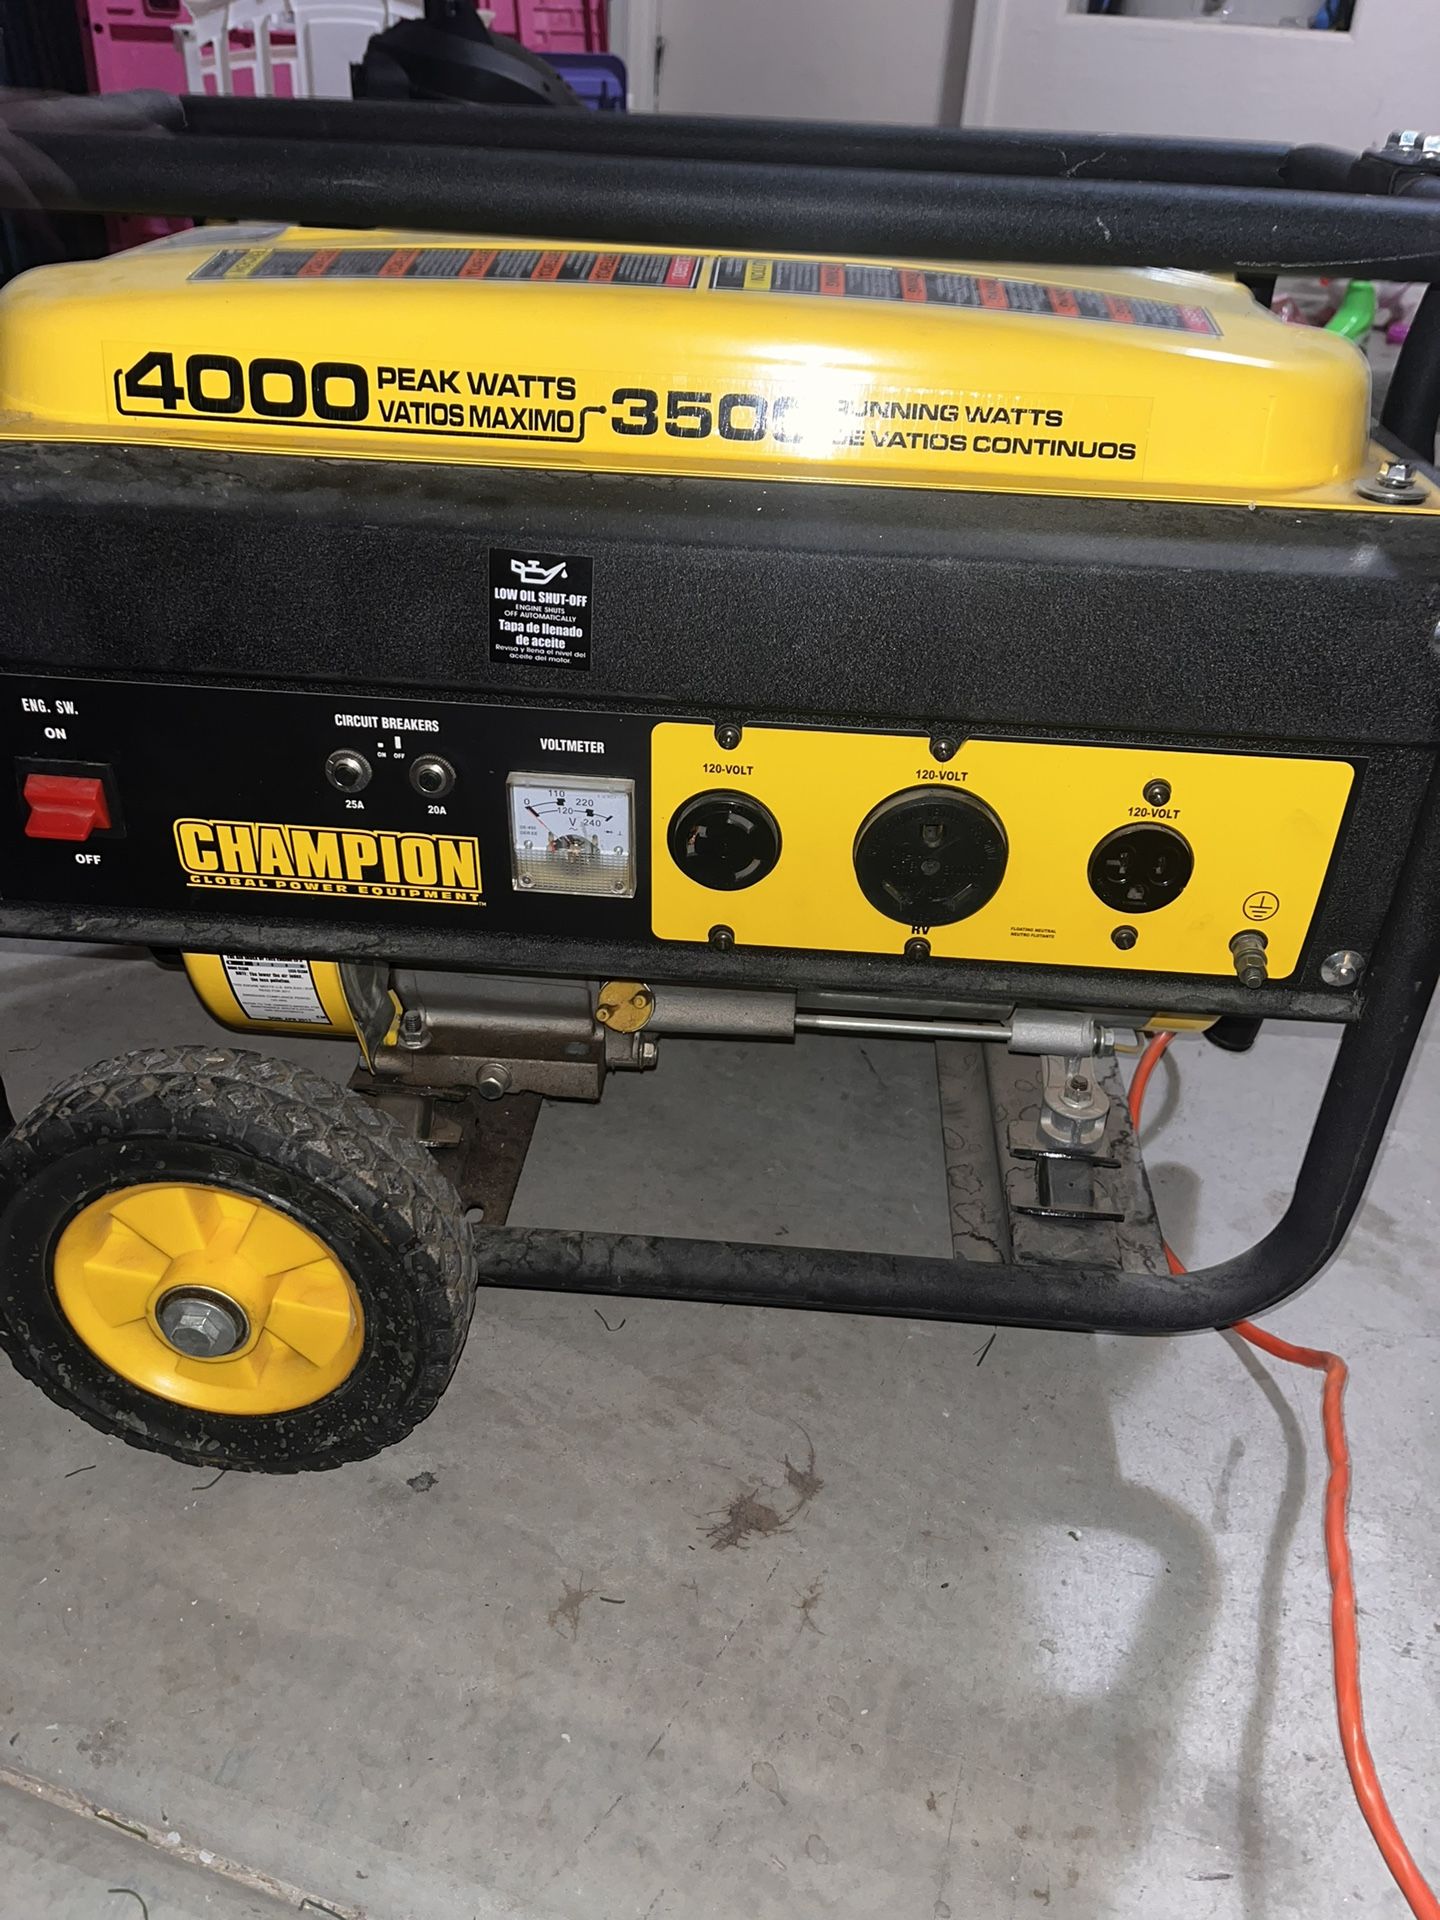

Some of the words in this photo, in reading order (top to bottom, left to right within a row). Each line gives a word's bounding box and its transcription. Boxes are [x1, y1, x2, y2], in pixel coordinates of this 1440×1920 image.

[125, 351, 370, 422] 4000
[377, 366, 461, 394] PEAK
[467, 372, 577, 401] WATTS
[378, 399, 464, 427] VATIOS
[469, 405, 575, 433] MAXIMO
[965, 405, 1064, 428] WATTS
[870, 430, 967, 452] VATIOS
[972, 435, 1137, 461] CONTINUOS
[494, 587, 518, 601] LOW
[519, 589, 537, 603] OIL
[538, 591, 588, 607] SHUT-OFF
[515, 603, 542, 613] ENGINE
[544, 605, 565, 614] SHUTS
[504, 609, 518, 617] OFF
[519, 611, 577, 623] AUTOMATICALLY
[498, 619, 525, 633] Tapa
[526, 621, 540, 634] de
[541, 622, 583, 638] llenado
[515, 633, 530, 646] de
[531, 636, 566, 649] aceite
[495, 643, 519, 652] Revisa
[526, 646, 545, 654] llena
[573, 651, 586, 659] del
[509, 652, 533, 660] aceite
[21, 697, 51, 713] ENG.
[55, 700, 79, 715] SW.
[334, 714, 379, 729] CIRCUIT
[381, 717, 440, 733] BREAKERS
[44, 727, 67, 740] ON
[540, 738, 605, 754] VOLTMETER
[377, 751, 387, 759] ON
[393, 752, 406, 760] OFF
[702, 763, 755, 776] 120-VOLT
[915, 769, 969, 783] 120-VOLT
[549, 789, 566, 799] 110
[345, 799, 365, 810] 25A
[523, 798, 530, 806] 0
[575, 797, 594, 808] 220
[427, 805, 447, 815] 20A
[557, 806, 574, 815] 120
[1127, 806, 1181, 820] 120-VOLT
[569, 817, 577, 827] V
[583, 817, 601, 828] 240
[75, 853, 101, 865] OFF
[174, 819, 481, 892] CHAMPION
[190, 874, 268, 888] GLOBAL
[276, 880, 348, 894] POWER
[359, 885, 480, 902] EQUIPMENT
[911, 924, 931, 935] RV
